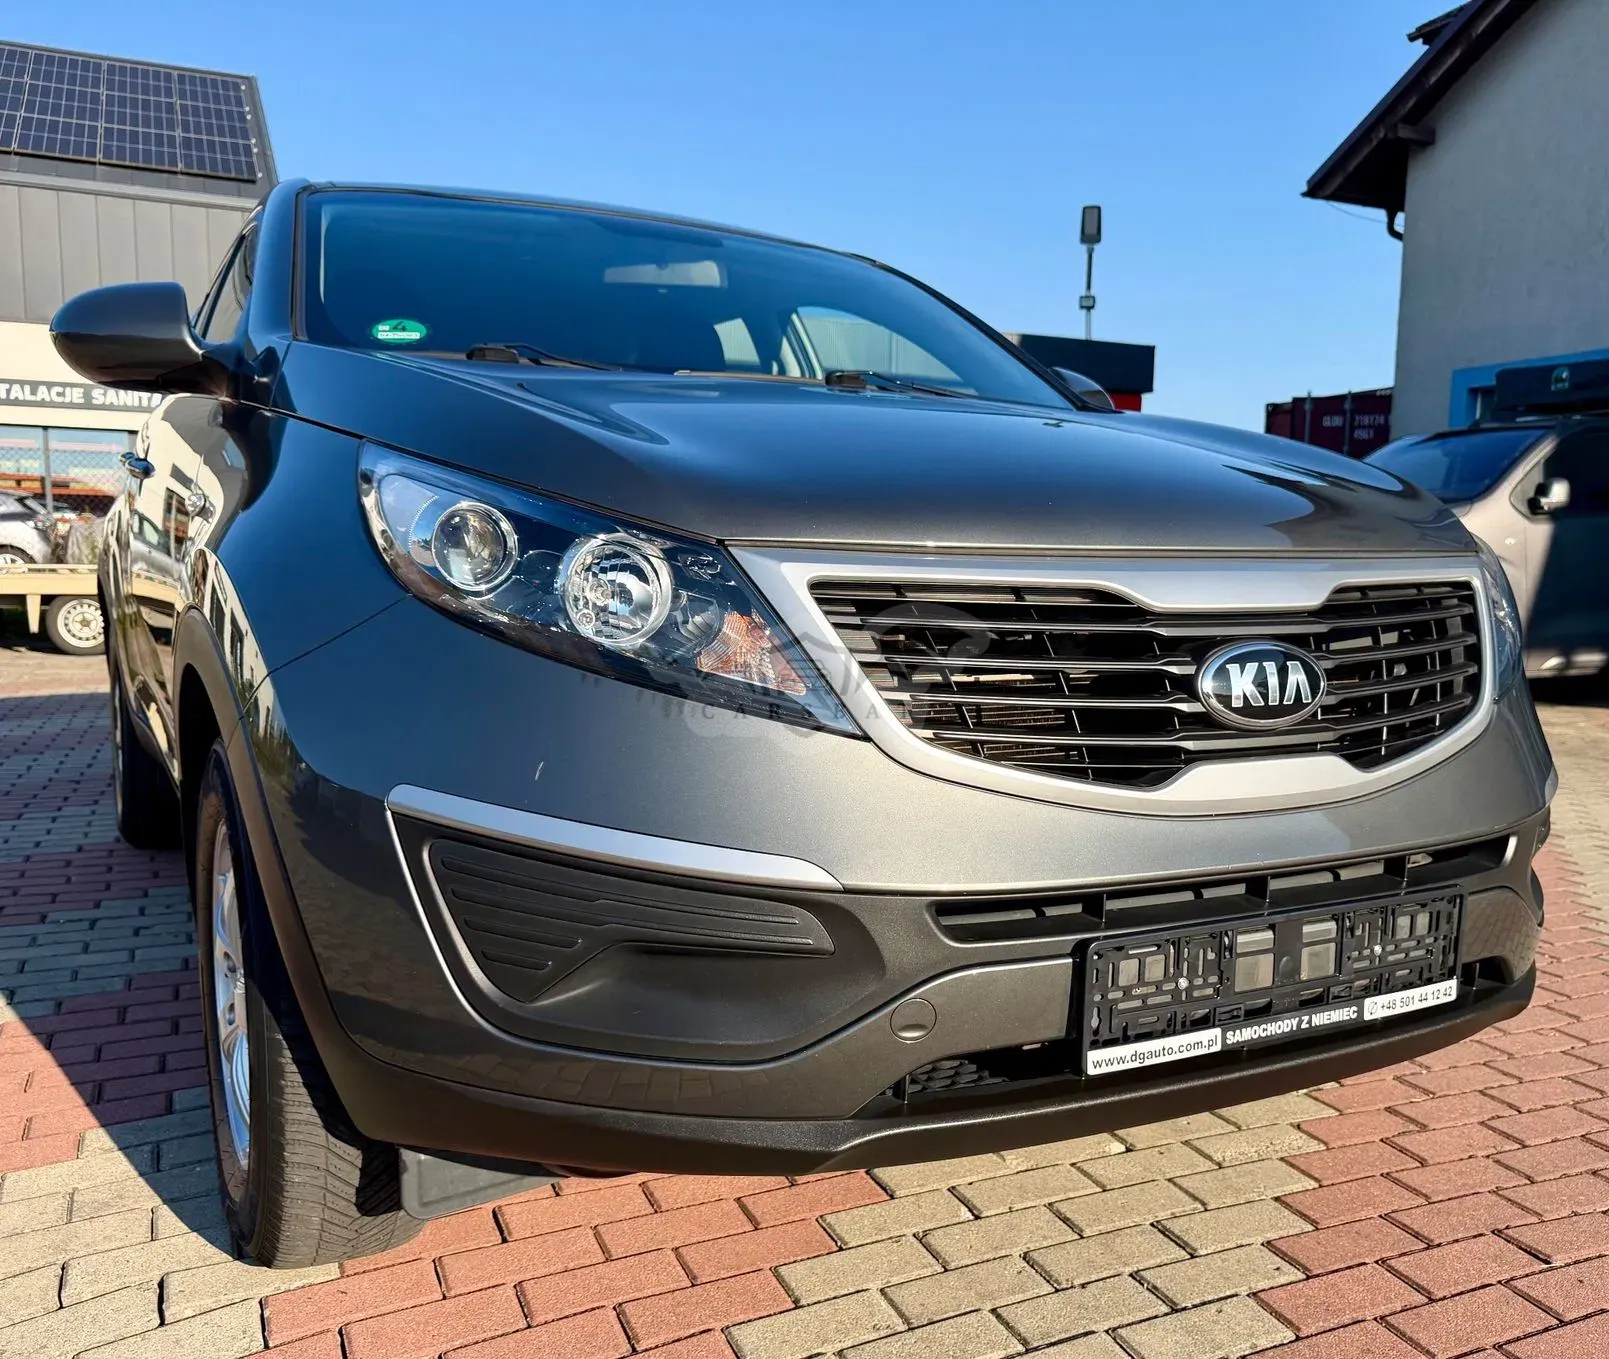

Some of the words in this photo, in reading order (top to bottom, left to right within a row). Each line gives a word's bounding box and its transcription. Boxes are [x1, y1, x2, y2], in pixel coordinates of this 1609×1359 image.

[1226, 661, 1312, 707] KIA
[1092, 1034, 1218, 1069] www.dgauto.com.pl
[1226, 1017, 1299, 1044] SAMOCHODY
[1300, 1015, 1310, 1029] Z
[1311, 1005, 1358, 1027] NIEMIEC
[1381, 998, 1397, 1011] +48
[1400, 995, 1415, 1008] 501
[1417, 992, 1429, 1003] 44
[1431, 988, 1441, 1001] 12
[1442, 985, 1453, 997] 42
